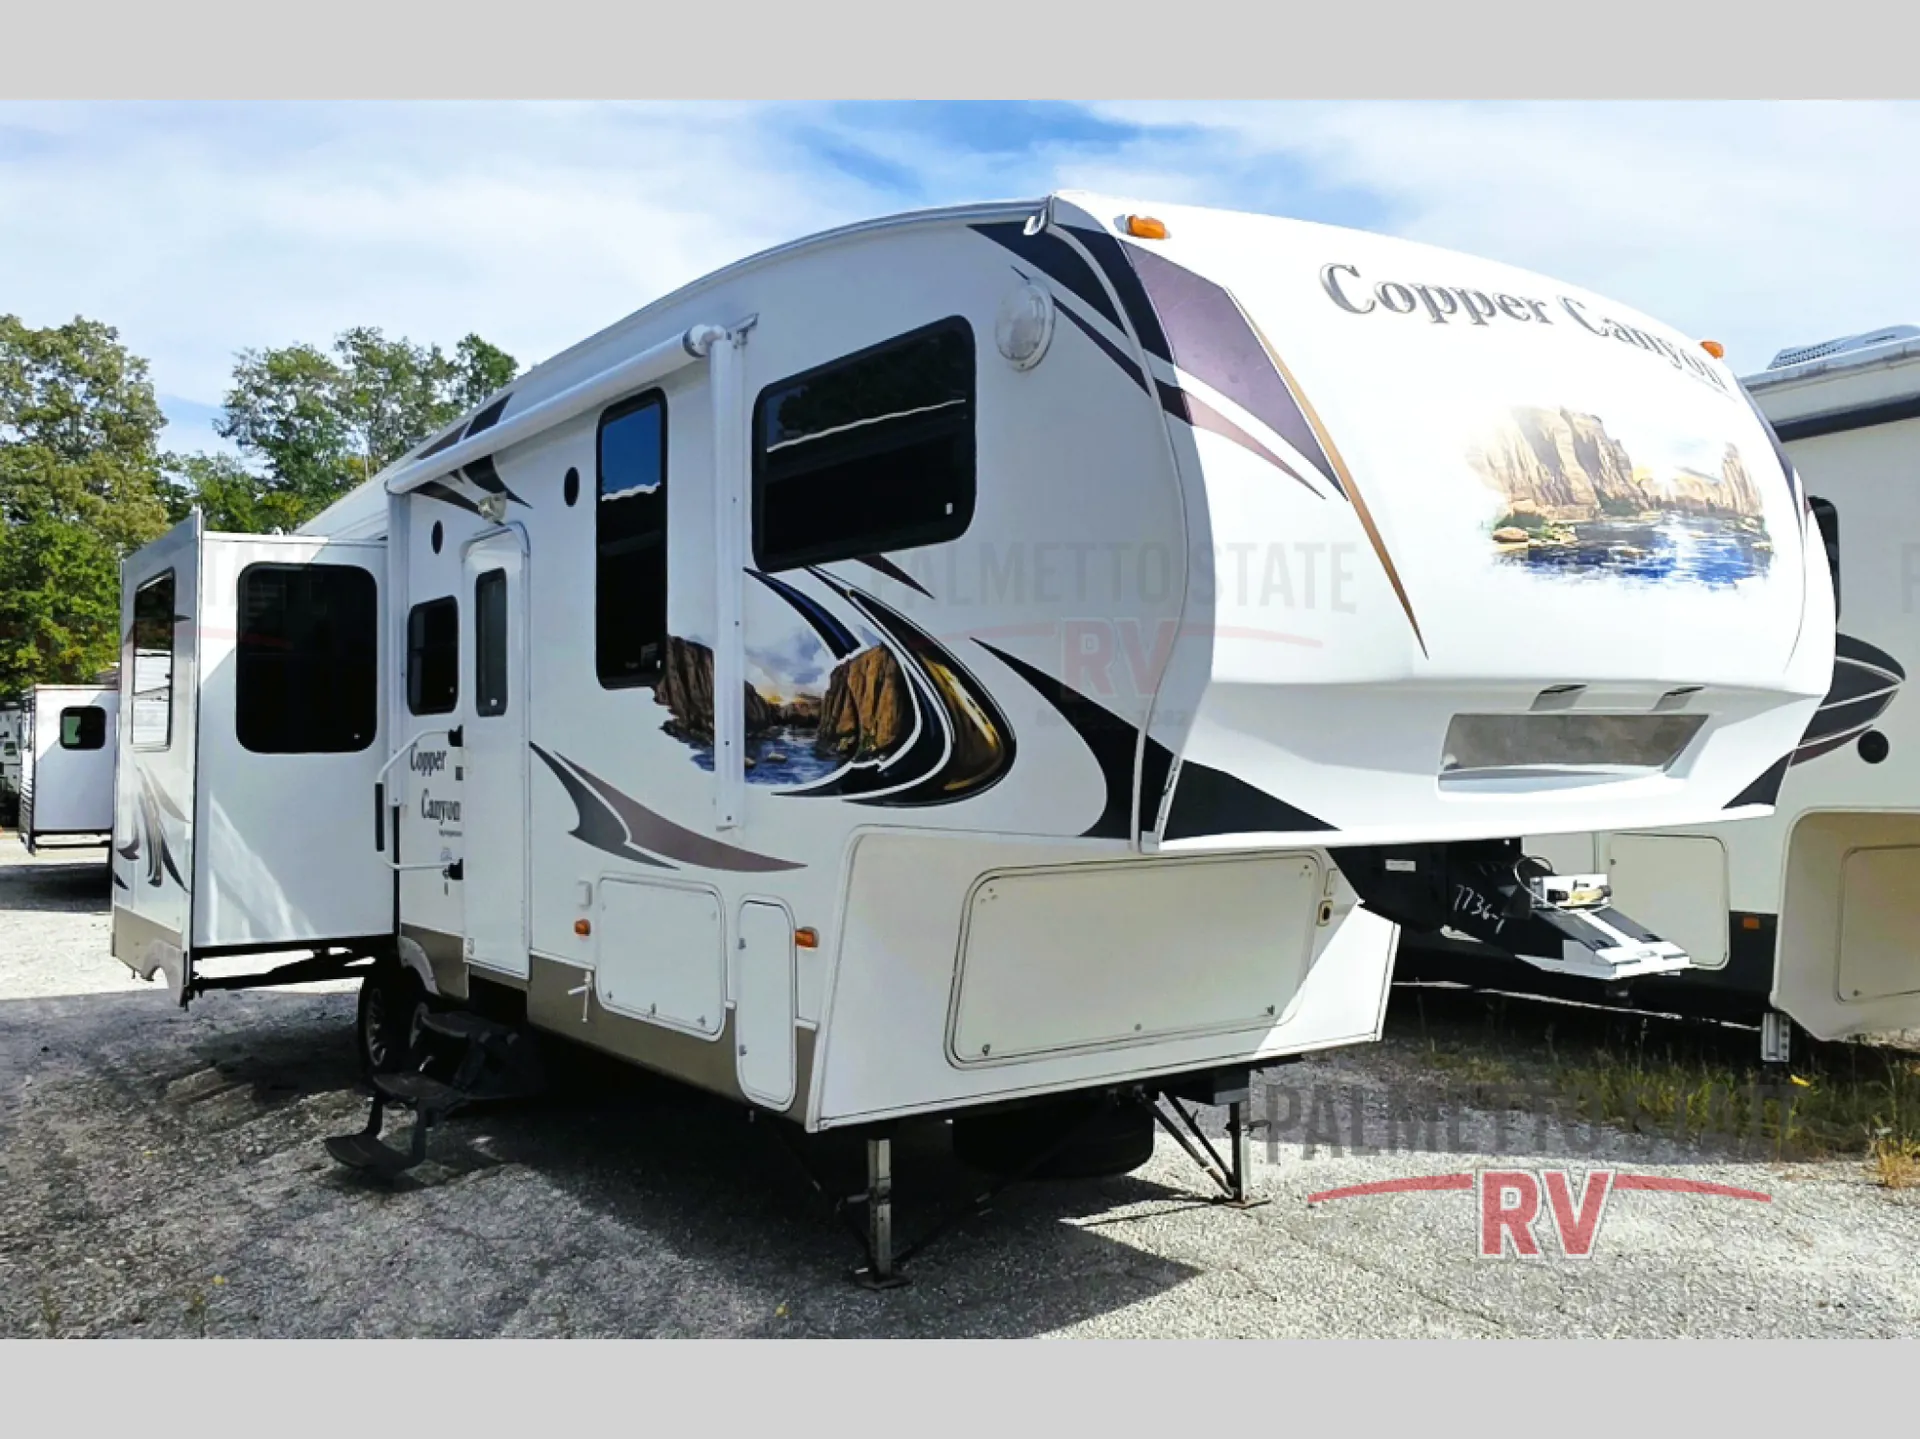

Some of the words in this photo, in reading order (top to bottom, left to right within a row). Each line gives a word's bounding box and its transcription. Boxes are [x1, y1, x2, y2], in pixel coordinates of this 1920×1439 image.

[1319, 262, 1554, 325] Copper
[1556, 295, 1729, 393] Canyon
[411, 742, 447, 777] Copper
[421, 788, 461, 826] Canyon
